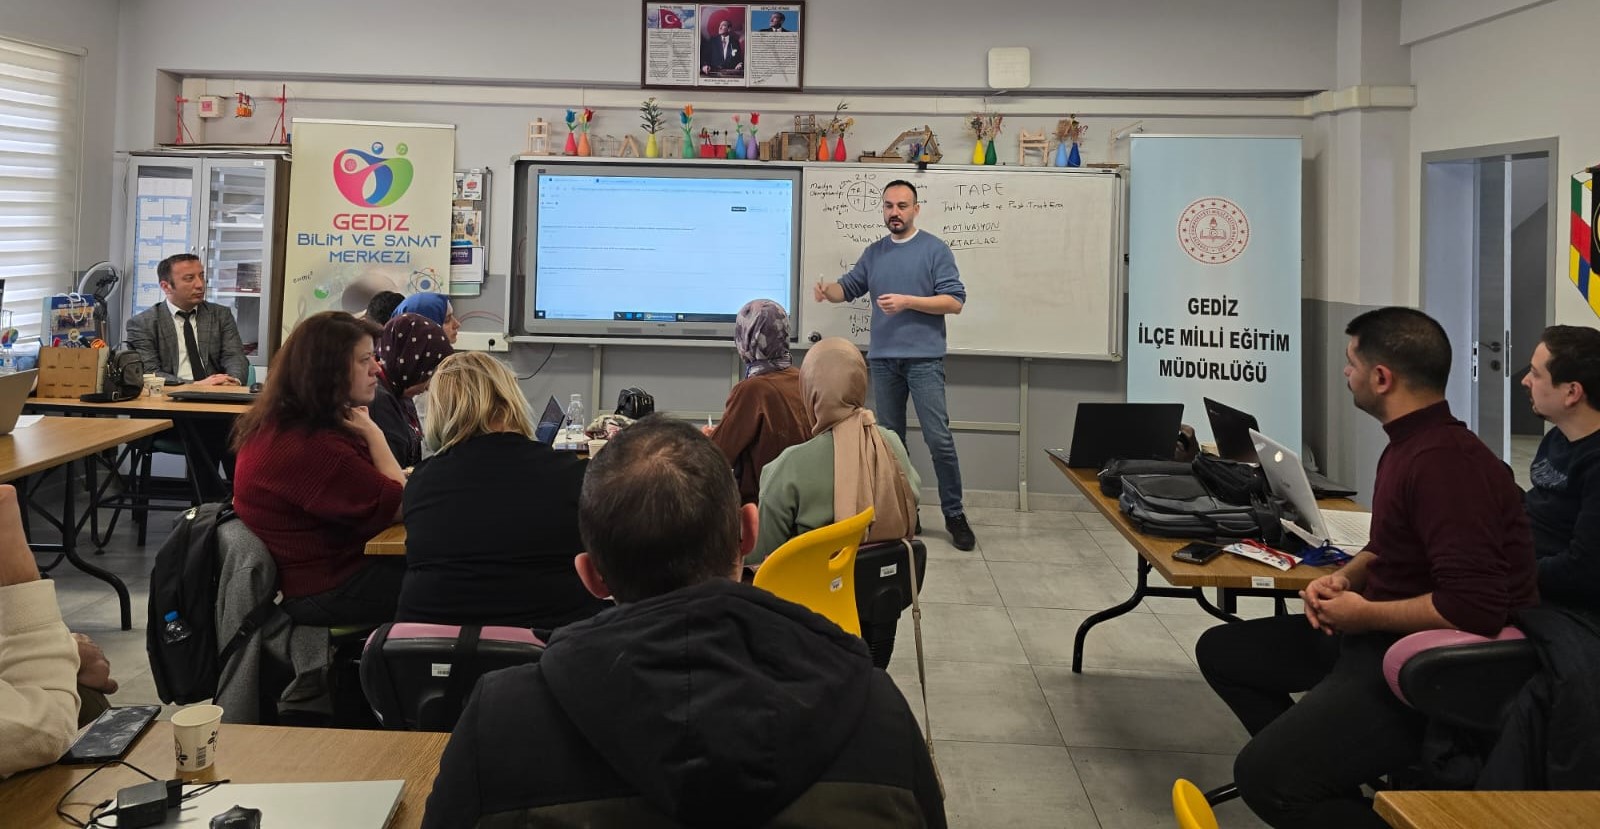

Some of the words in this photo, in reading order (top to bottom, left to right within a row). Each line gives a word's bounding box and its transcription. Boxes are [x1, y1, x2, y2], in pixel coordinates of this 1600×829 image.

[954, 182, 1005, 196] TAPE
[298, 233, 343, 246] BİLİM
[352, 234, 375, 246] VE
[385, 234, 441, 247] SANAT
[329, 250, 410, 264] MERKEZİ
[1188, 294, 1238, 316] GEDİZ
[1138, 322, 1175, 349] İLÇE
[1180, 325, 1224, 348] MİLLİ
[1230, 328, 1290, 352] EĞİTİM
[1159, 356, 1267, 383] MÜDÜRLÜĞÜ
